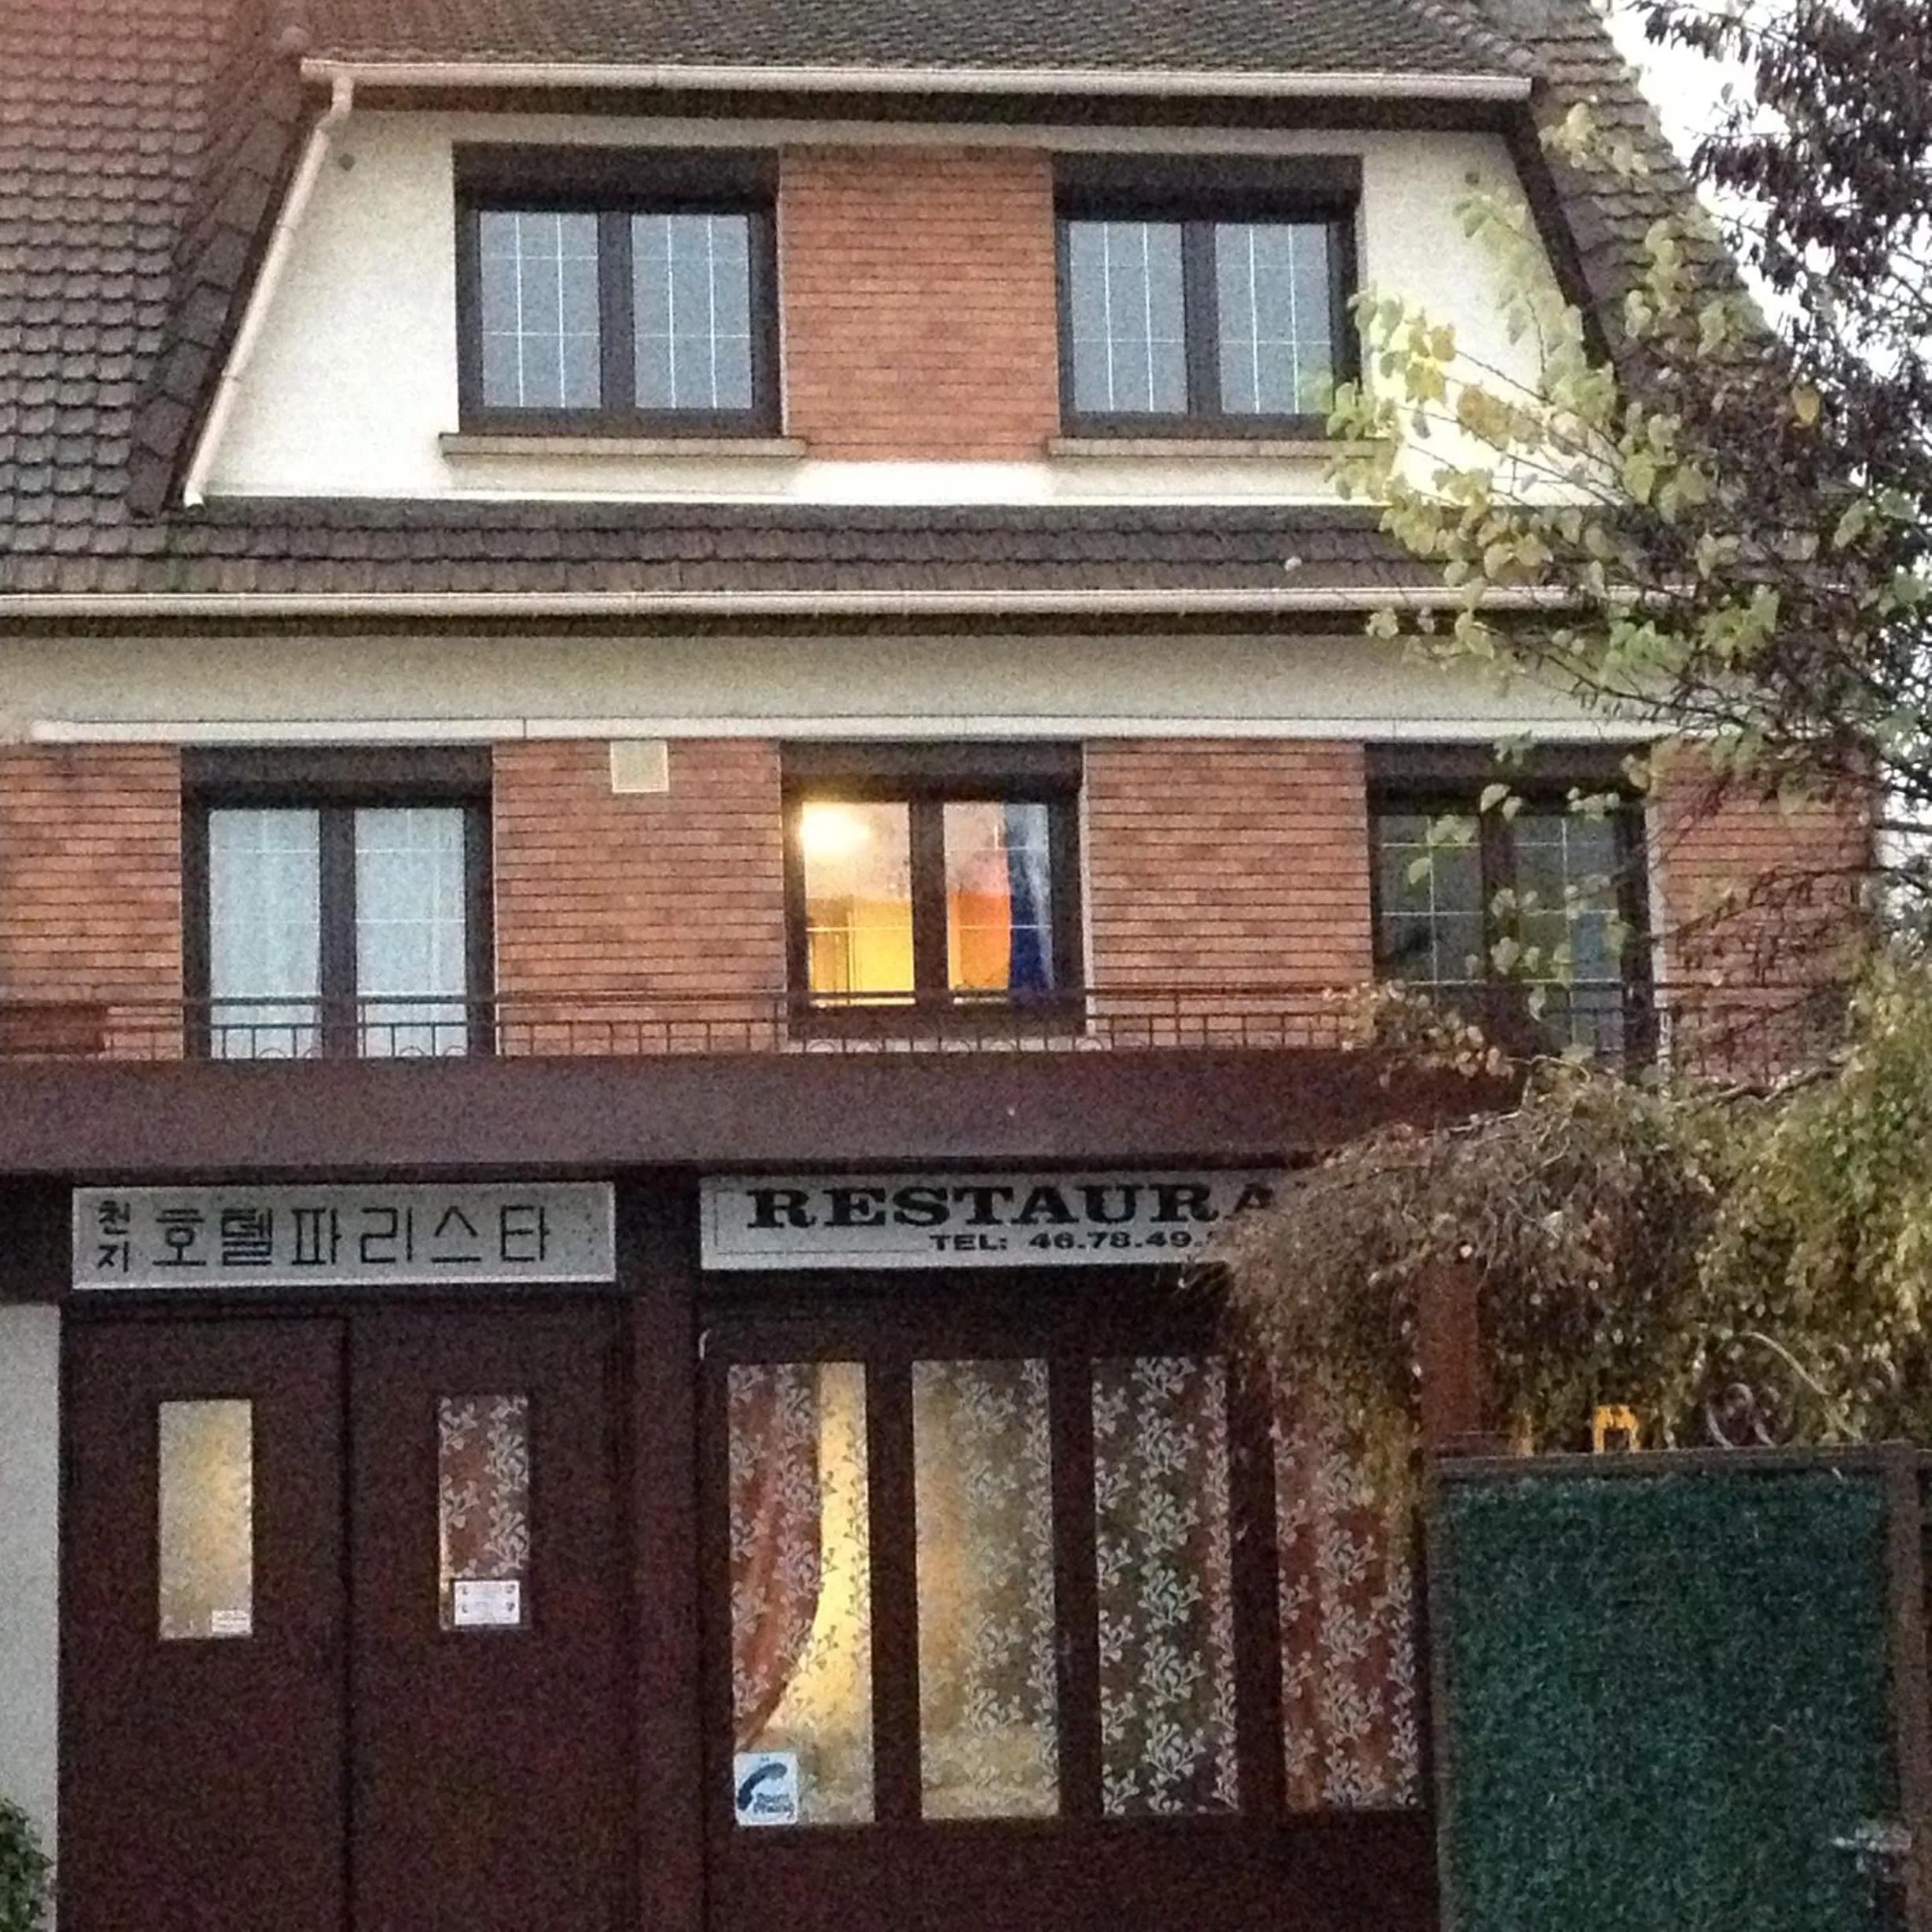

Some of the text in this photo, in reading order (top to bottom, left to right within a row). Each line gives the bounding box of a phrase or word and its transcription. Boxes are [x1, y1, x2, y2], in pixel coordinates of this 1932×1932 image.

[746, 1183, 1275, 1228] RESTAURA
[928, 1230, 1217, 1252] TEL: 46.78.49.
